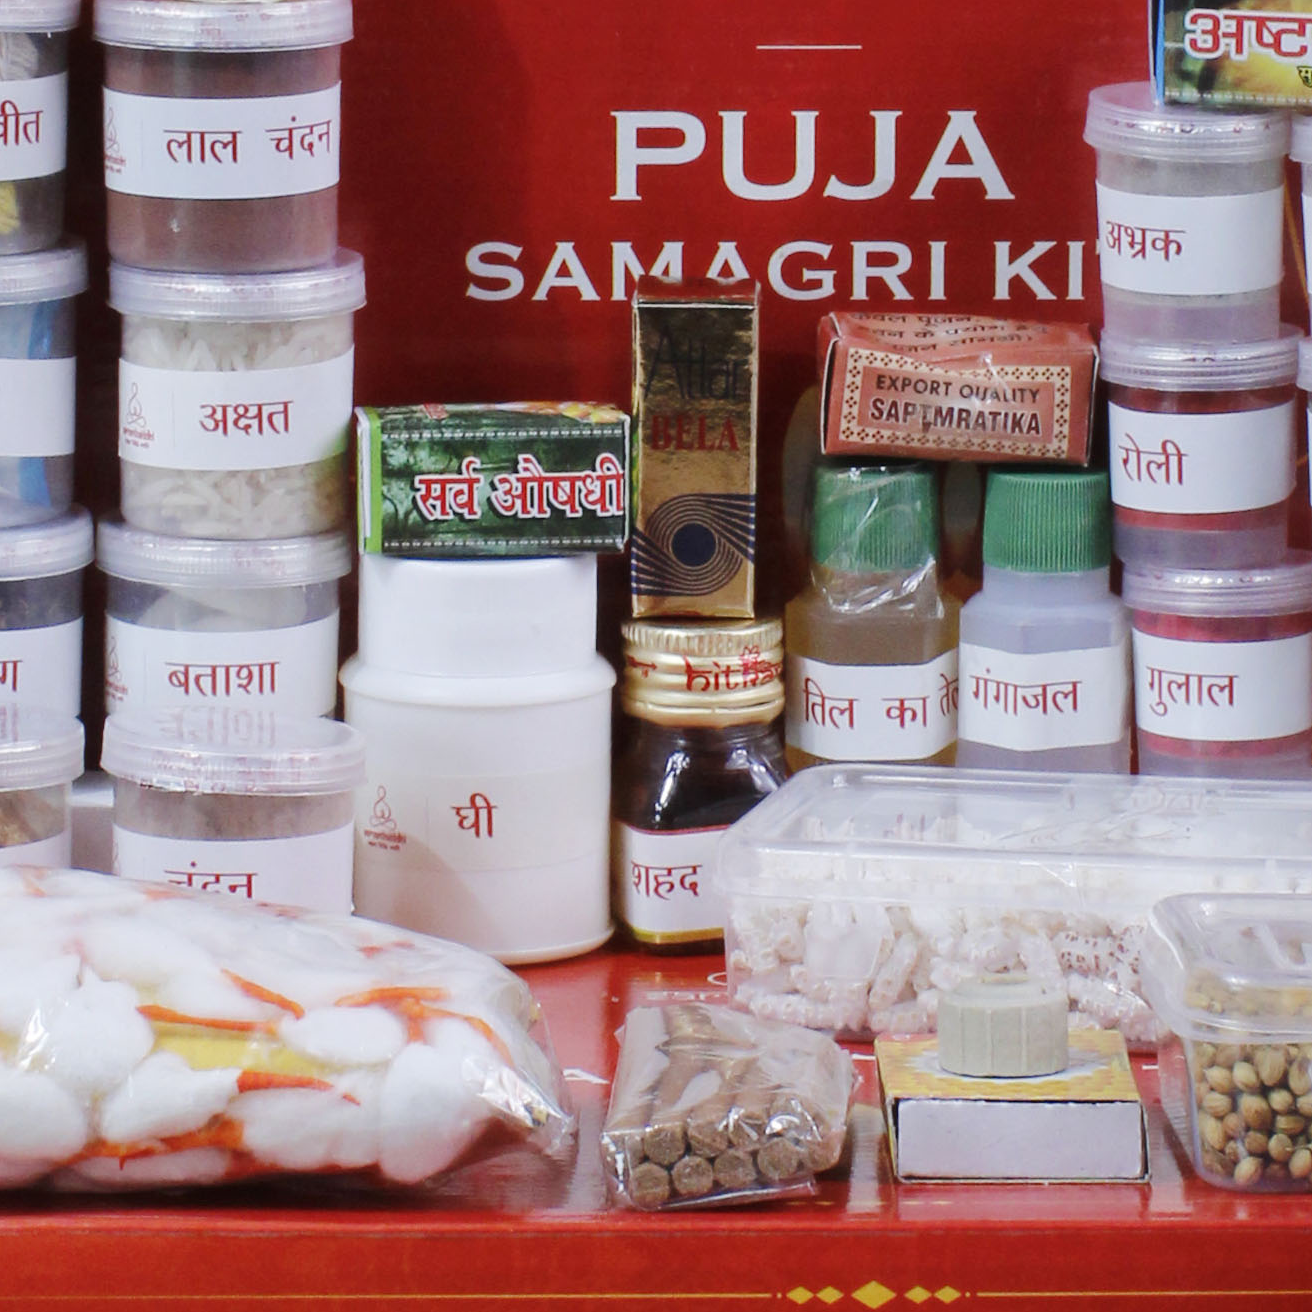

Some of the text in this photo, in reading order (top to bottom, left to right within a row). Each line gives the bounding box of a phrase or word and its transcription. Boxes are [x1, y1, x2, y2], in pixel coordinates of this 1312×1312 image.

[163, 116, 332, 165] लाल चंदन
[610, 110, 1015, 202] PUJA
[1105, 221, 1186, 263] अभ्रक
[992, 240, 1099, 301] KI
[875, 374, 1042, 405] EXPORT QUALITY
[199, 399, 294, 438] अक्षत
[651, 414, 741, 452] BELA
[1118, 434, 1189, 486] रोली
[415, 455, 485, 520] सर्व
[165, 660, 281, 697] बताशा
[802, 676, 860, 729] तिल
[881, 695, 931, 729] का
[968, 667, 1084, 716] गंगाजल
[1145, 666, 1239, 717] गुलाल
[450, 792, 499, 840] घी
[630, 861, 703, 902] शहद
